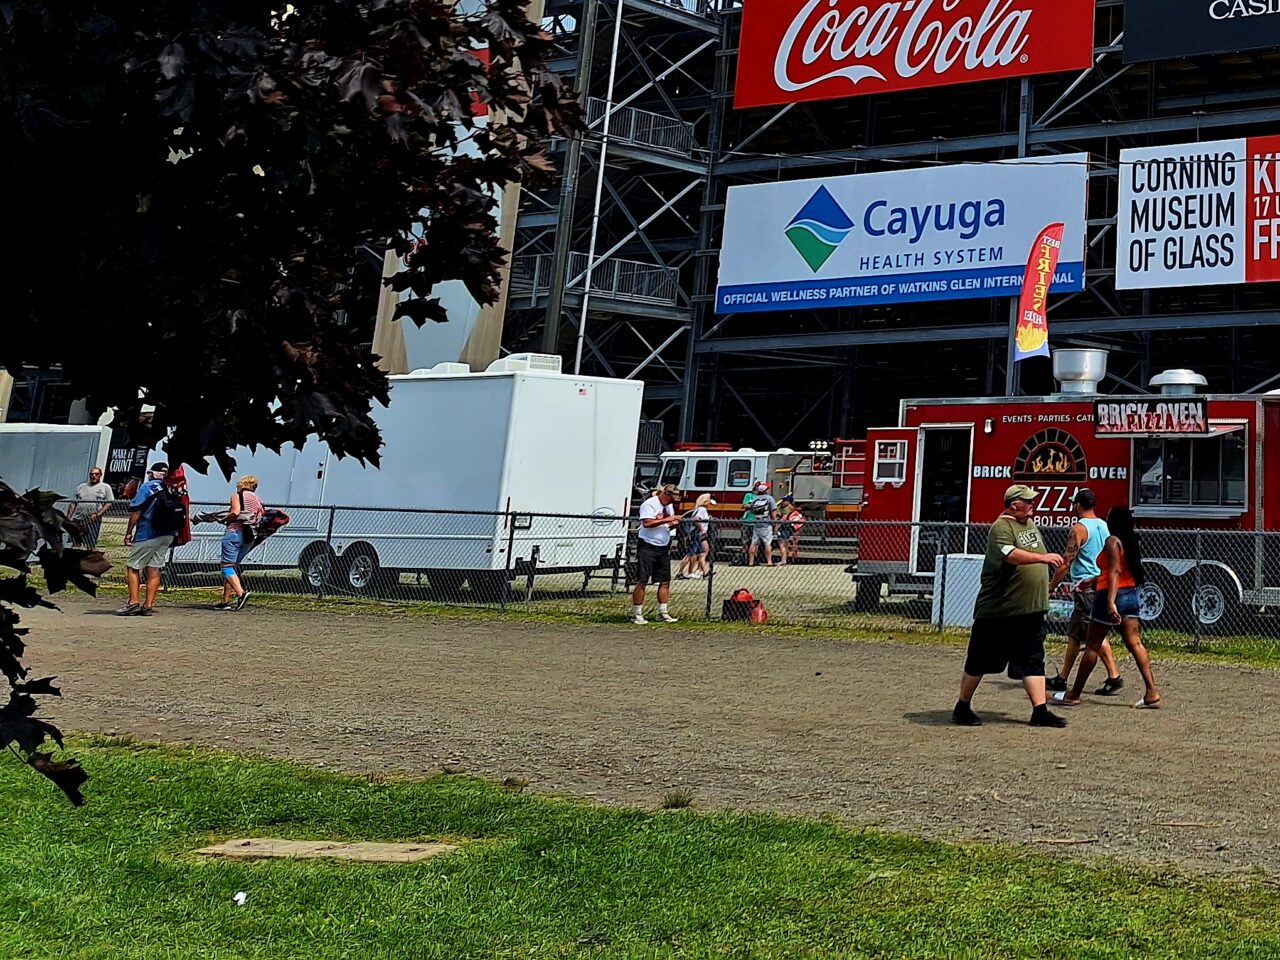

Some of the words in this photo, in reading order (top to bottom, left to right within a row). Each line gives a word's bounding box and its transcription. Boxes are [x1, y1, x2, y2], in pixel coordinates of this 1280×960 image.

[1131, 151, 1235, 193] CORNING
[1130, 191, 1235, 234] MUSEUM
[1254, 196, 1270, 217] 17
[863, 198, 1005, 243] Cayuga
[860, 252, 924, 271] HEALTH
[934, 246, 1003, 265] SYSTEM
[1129, 237, 1157, 272] OF
[1163, 233, 1234, 270] GLASS
[723, 292, 768, 305] OFFICIAL
[771, 288, 827, 302] WELLNESS
[829, 285, 878, 299] PARTNER
[881, 284, 896, 294] OF
[898, 280, 948, 294] WATKINS
[950, 278, 981, 290] GLEN
[984, 272, 1075, 288] INTERNNAL
[1002, 415, 1032, 423] EVENTS
[1038, 414, 1071, 422] PARTIES
[1097, 402, 1149, 425] BRICK
[1156, 402, 1203, 425] OVEN
[1126, 413, 1175, 430] PIZZA
[109, 458, 133, 472] COUNT
[112, 448, 127, 459] MAKE
[973, 465, 1011, 478] BRICK
[1090, 466, 1127, 479] OVEN
